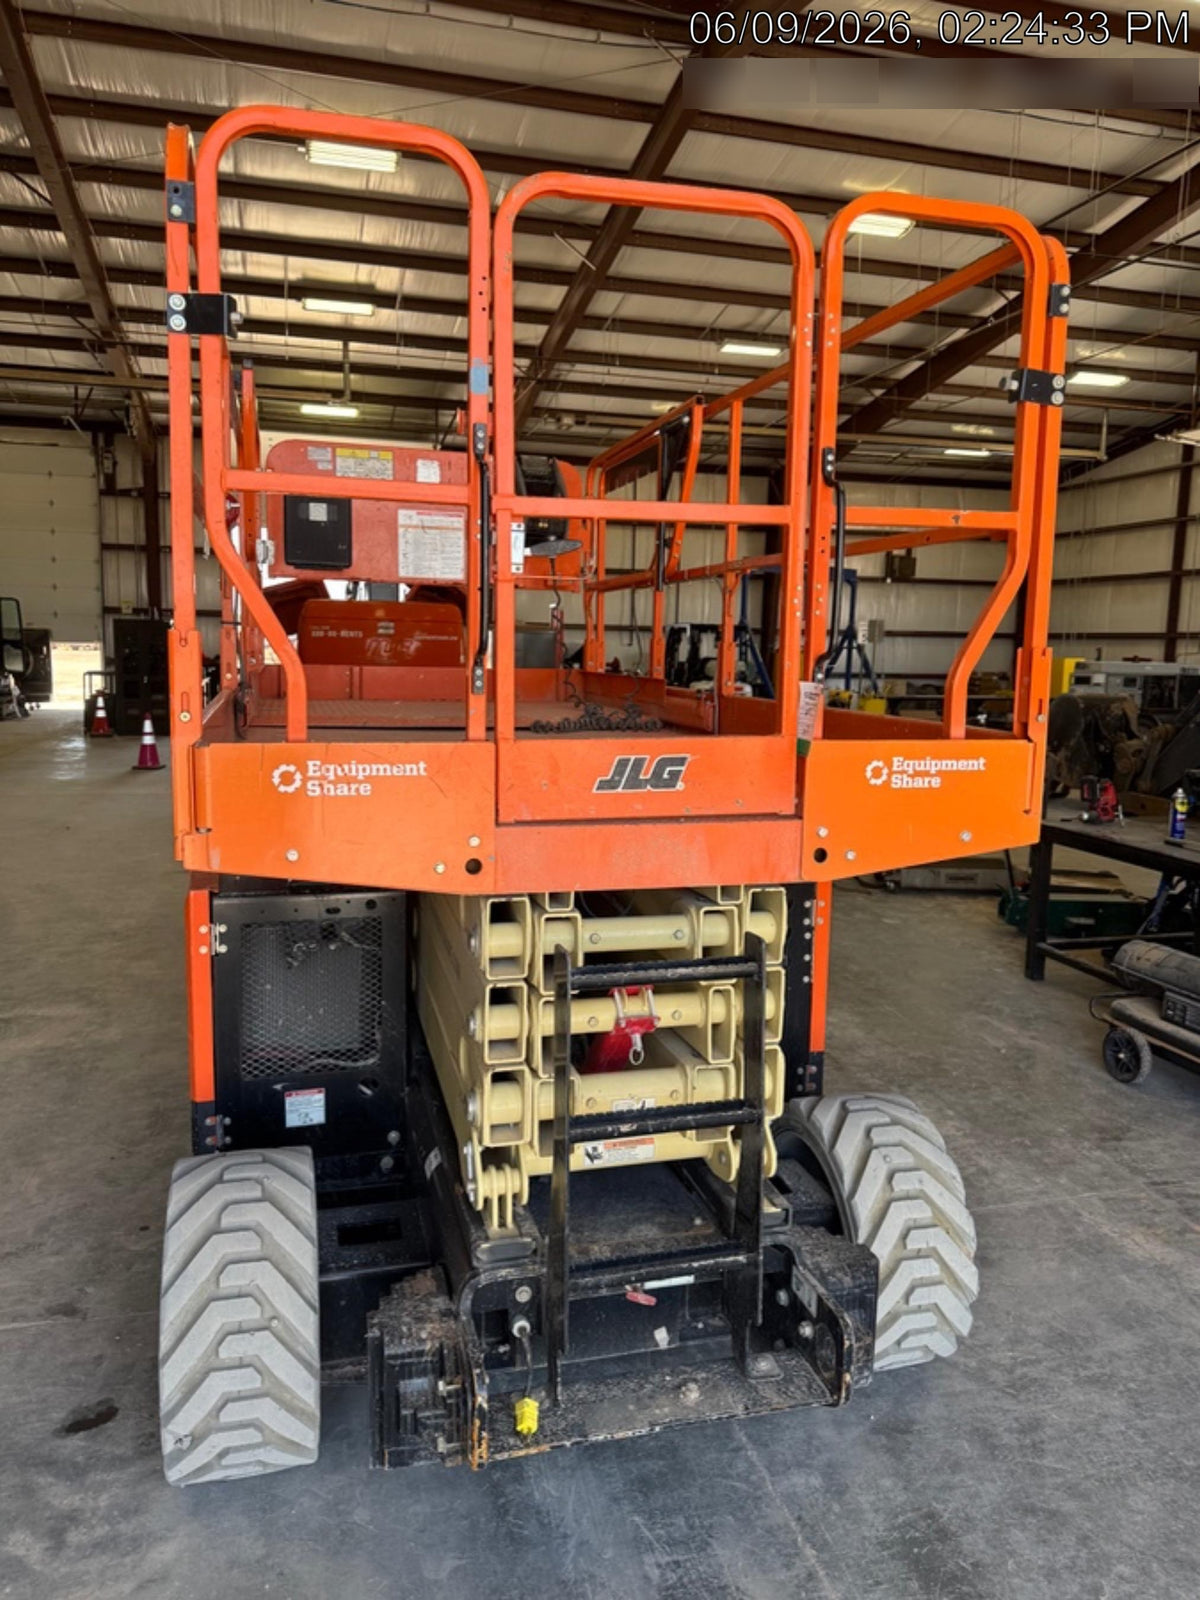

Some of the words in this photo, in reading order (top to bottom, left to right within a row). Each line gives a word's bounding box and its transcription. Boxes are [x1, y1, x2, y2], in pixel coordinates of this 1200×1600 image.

[306, 760, 427, 780] Equipment
[595, 755, 690, 791] JLG
[891, 756, 987, 773] Equipment
[306, 780, 372, 796] Share
[891, 773, 942, 788] Share
